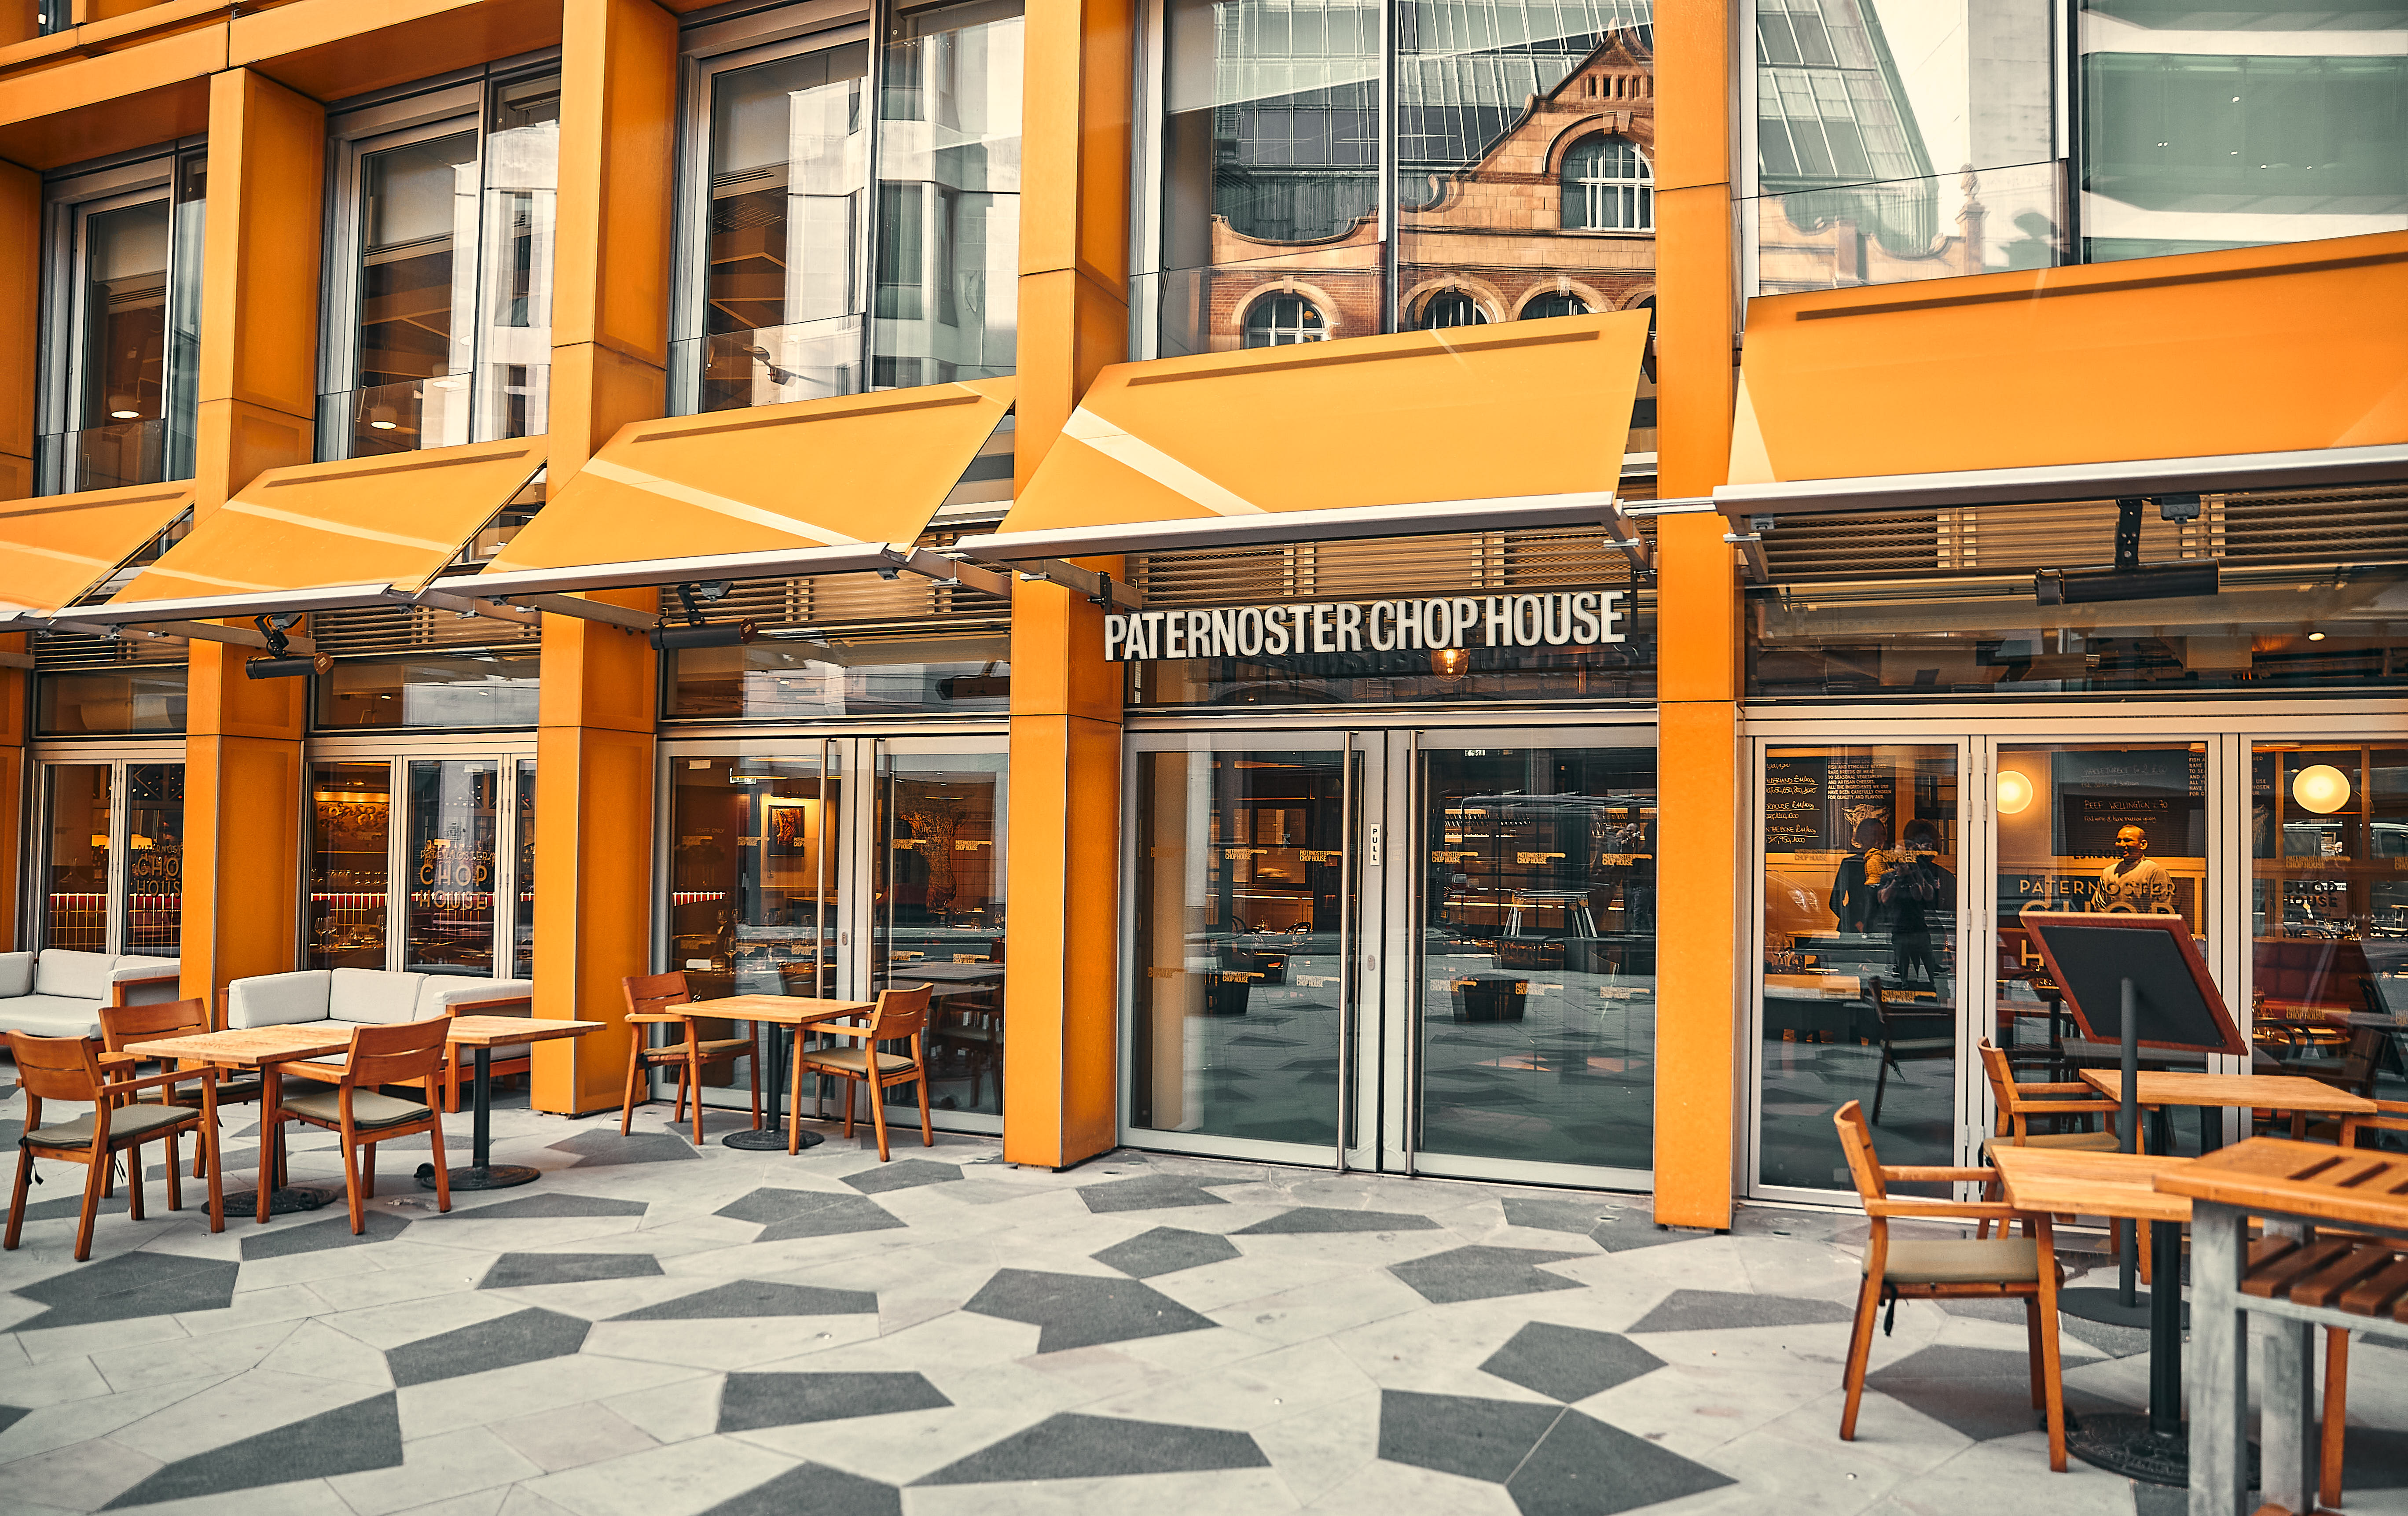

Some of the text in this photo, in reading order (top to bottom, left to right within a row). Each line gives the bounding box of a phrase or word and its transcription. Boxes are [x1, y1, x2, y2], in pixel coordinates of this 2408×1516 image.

[1106, 591, 1626, 661] PATERNOSTER CHOP HOUSE
[2084, 800, 2103, 810] BEEF
[138, 857, 179, 876] CHO
[420, 864, 488, 887] CHOP
[137, 880, 180, 897] HOUS
[2020, 880, 2176, 895] PATERNOSTER
[420, 890, 487, 910] HOUSE
